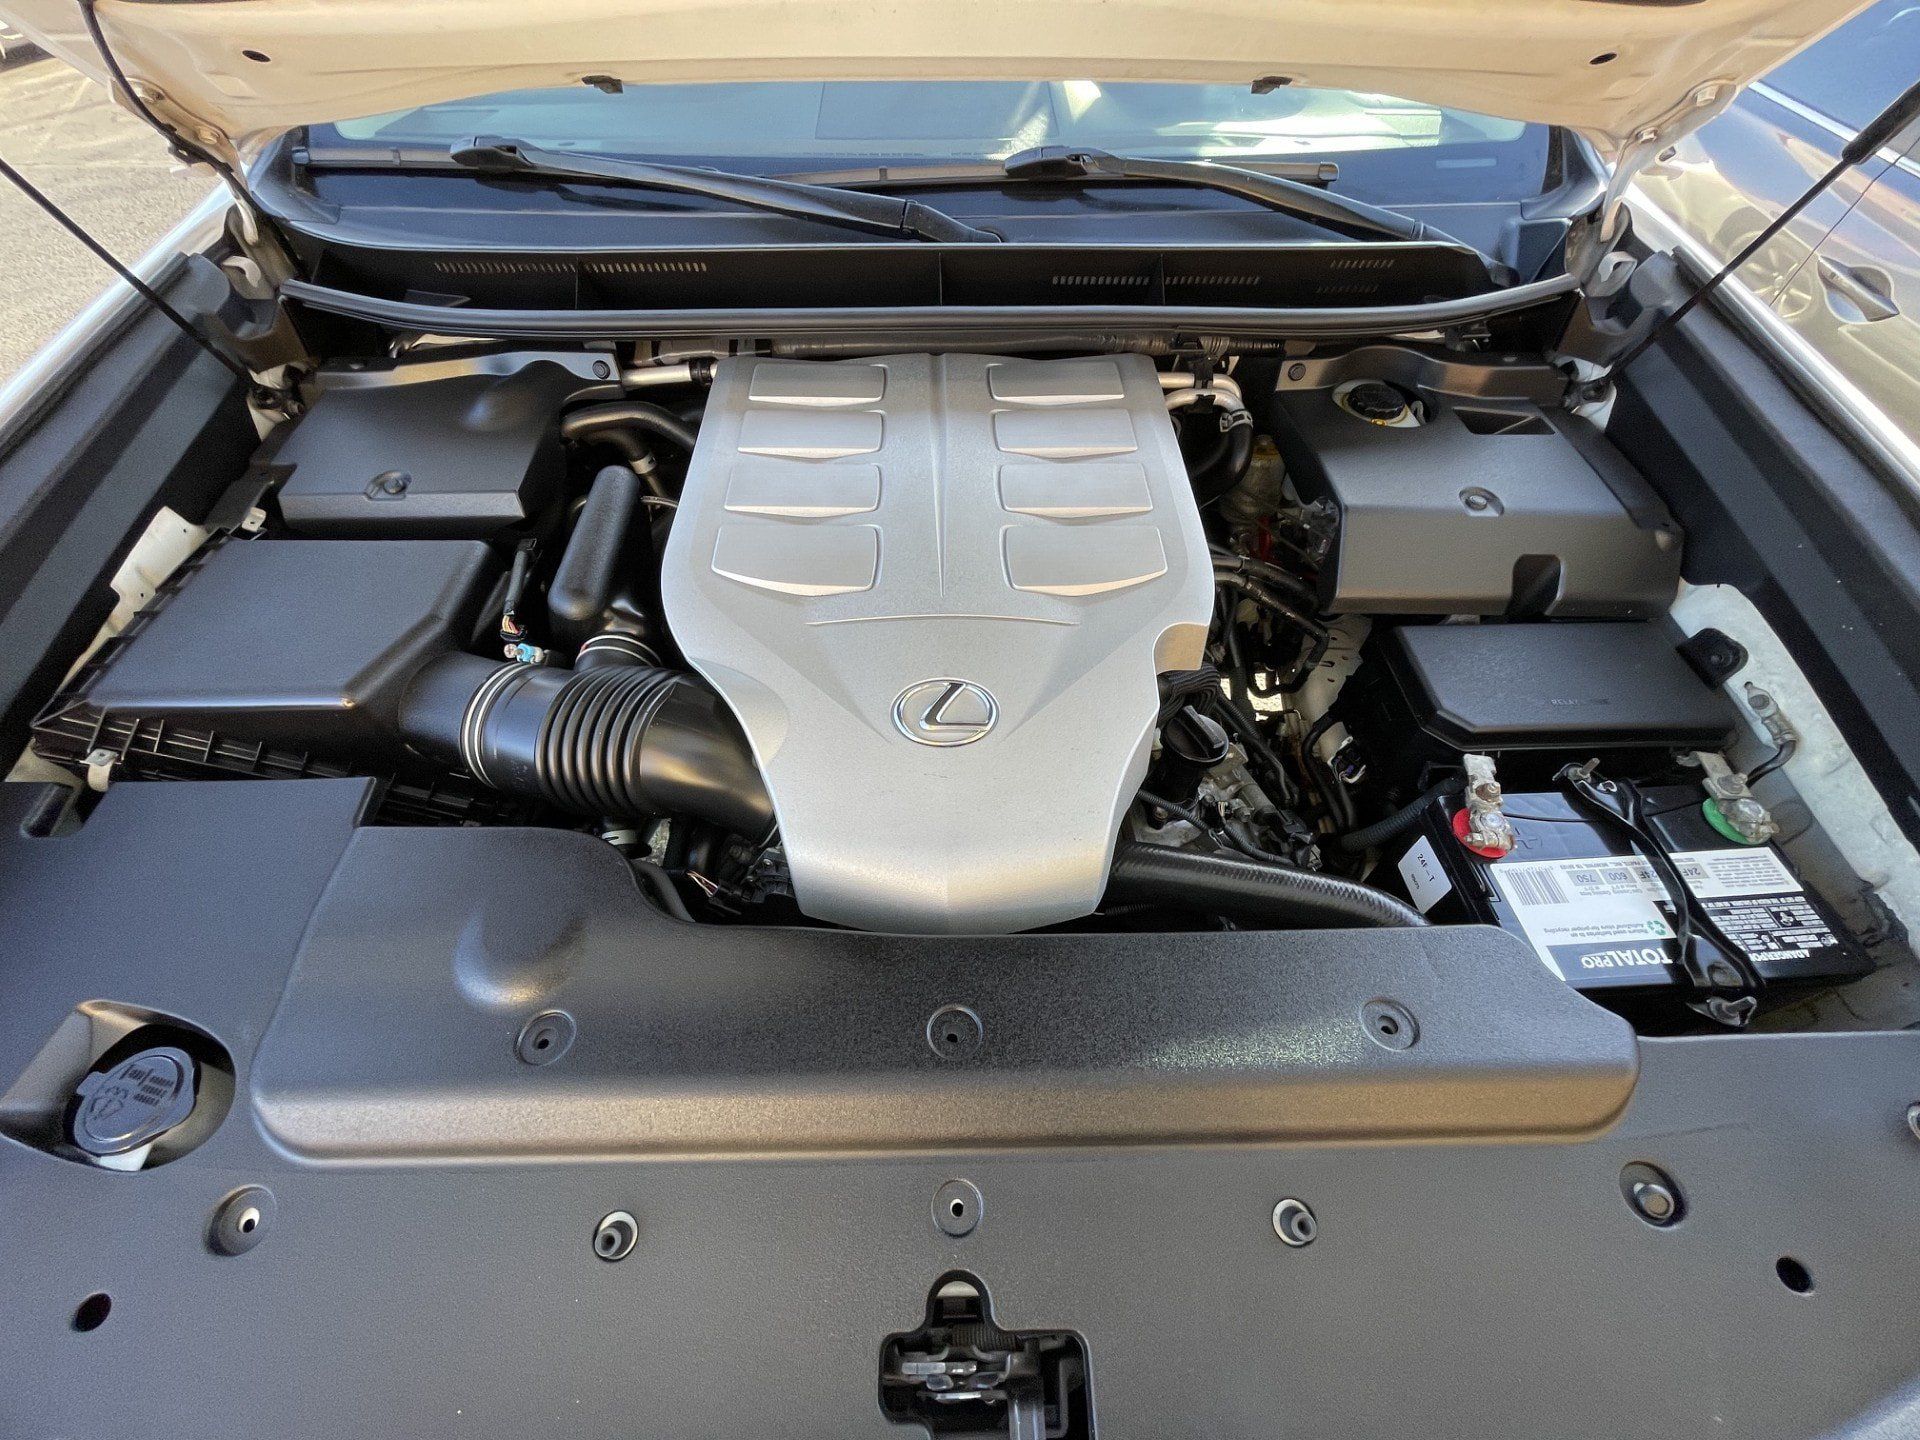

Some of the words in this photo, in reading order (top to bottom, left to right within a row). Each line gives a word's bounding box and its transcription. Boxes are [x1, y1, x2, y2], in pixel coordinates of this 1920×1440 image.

[1608, 872, 1628, 882] 600
[1639, 870, 1656, 880] 24F
[1682, 867, 1701, 877] 24F
[1576, 874, 1596, 884] 750
[1543, 926, 1570, 934] recycling
[1580, 947, 1674, 969] TOTALPRO
